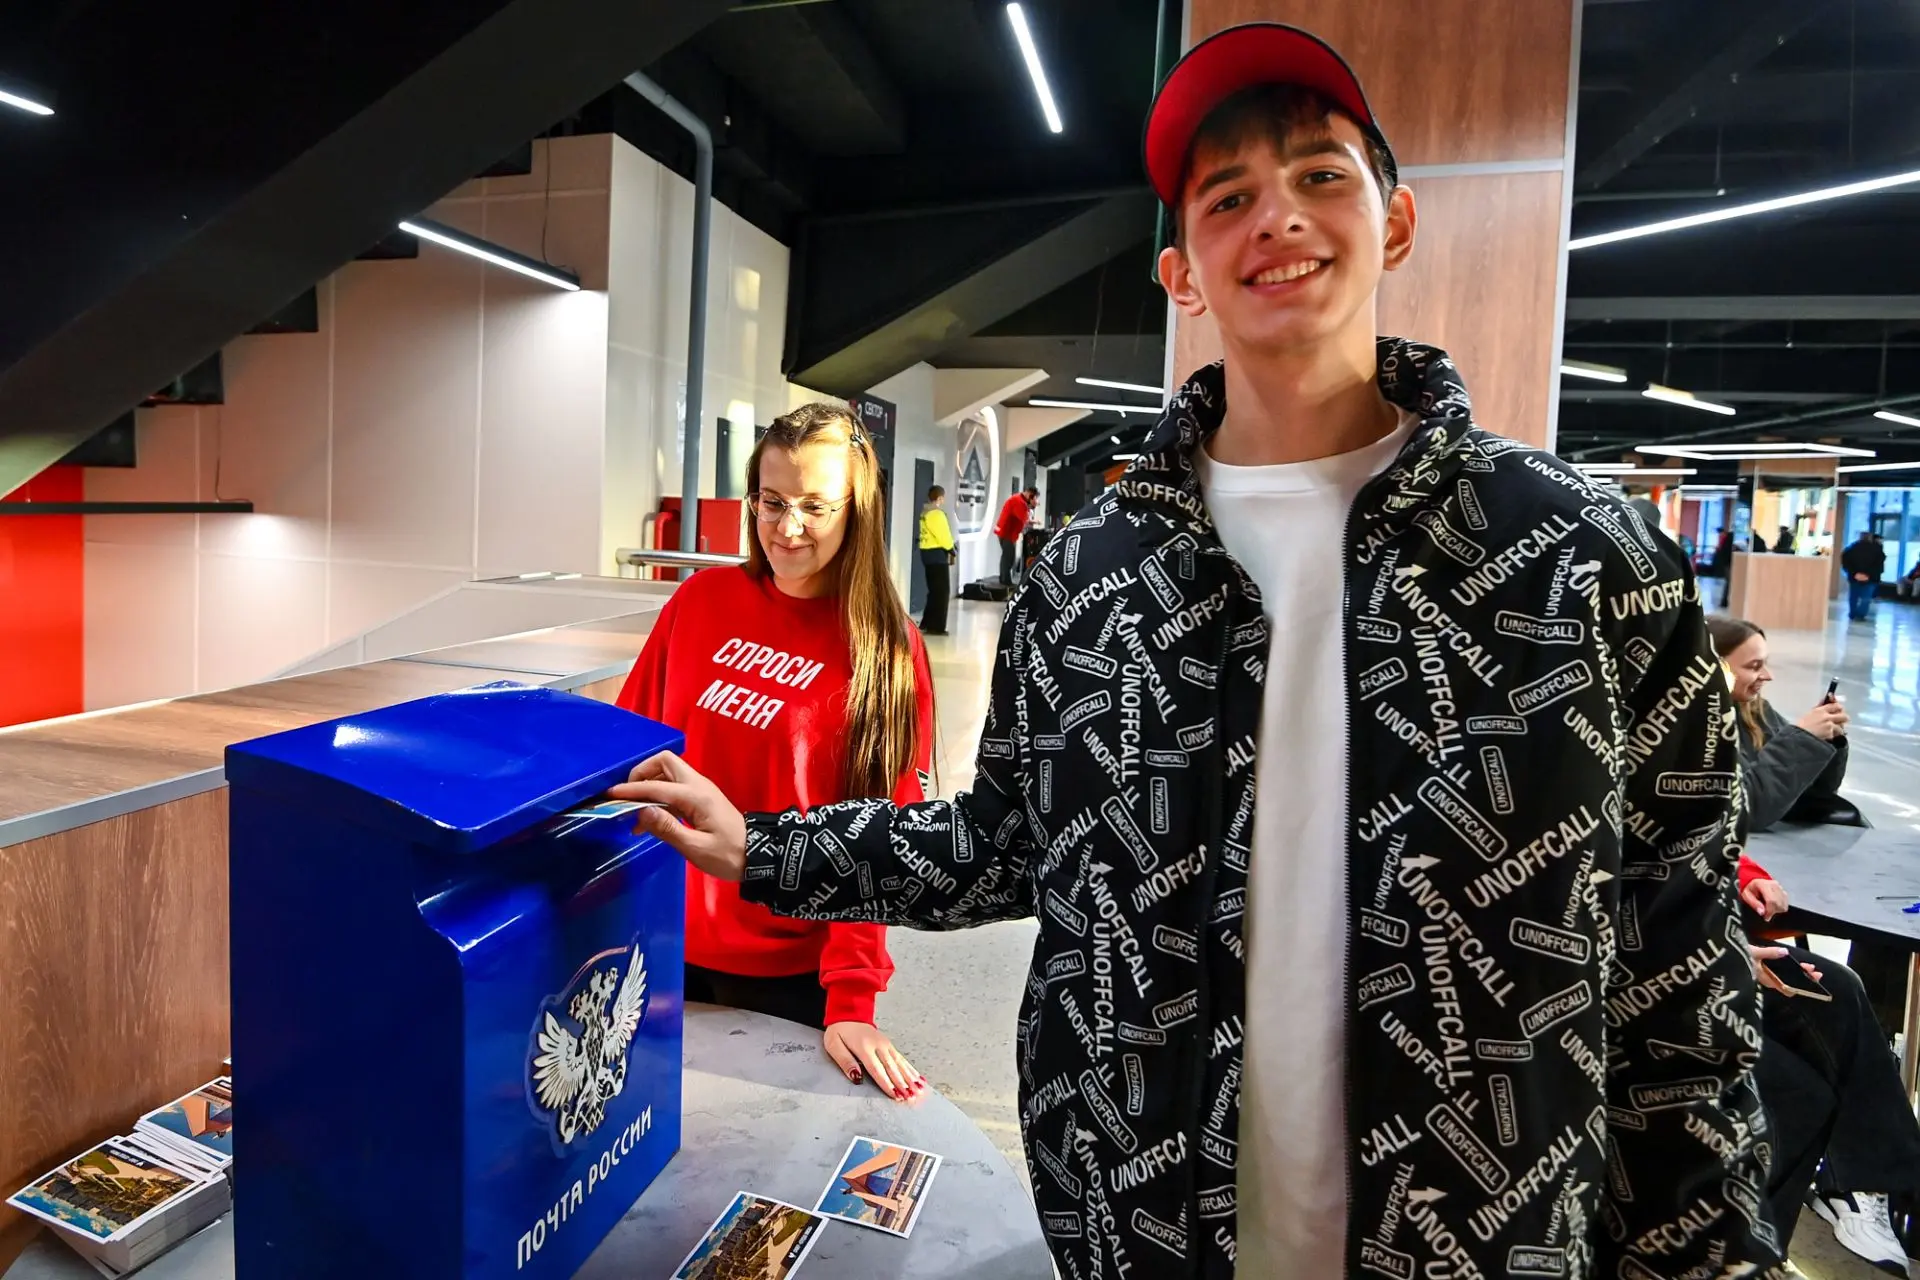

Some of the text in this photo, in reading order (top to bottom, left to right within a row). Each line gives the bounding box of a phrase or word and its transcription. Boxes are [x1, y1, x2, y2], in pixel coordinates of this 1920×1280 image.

[1523, 455, 1622, 524] UNOFFLL
[1450, 514, 1580, 607] UNOFFCALL
[1589, 511, 1651, 576] UNOFFCALL
[1045, 567, 1138, 646] UNOFFCALL
[1143, 561, 1178, 607] UNOFFCALL
[1367, 547, 1401, 616] UNOFFCALL
[1544, 545, 1577, 617] UNOFFCALL
[1012, 606, 1029, 667] UNOFFCALL
[1093, 595, 1129, 652] UNOFFCALL
[1391, 571, 1504, 688] UNOFFCALL
[1502, 616, 1577, 639] UNOFFCALL
[712, 637, 825, 690] СПРОСИ
[1115, 616, 1177, 725] UNOFFCALL
[1410, 625, 1465, 762] UNOFFCALL
[1514, 666, 1587, 710] UNOFFCALL
[696, 679, 785, 730] МЕНЯ
[1062, 696, 1107, 727] UNOFFCALL
[1118, 662, 1142, 783] UNOFFCALL
[1470, 719, 1524, 732] UNOFFCALL
[1625, 654, 1718, 776] UNOFFCALL
[1702, 691, 1721, 769] UNOFFCALL
[1082, 726, 1141, 810] UNOFFLL
[1374, 700, 1473, 791] UNOFFLL
[1485, 750, 1509, 810] UNOFFCALL
[1107, 801, 1153, 867] UNOFFCALL
[1154, 780, 1166, 831] UNOFFCALL
[1426, 784, 1499, 855] UNOFFCALL
[785, 836, 805, 886] UNOFFCALL
[1373, 831, 1408, 911] UNOFFCALL
[1463, 804, 1601, 909] UNOFFCALL
[1561, 849, 1596, 929] UNOFFCALL
[1086, 868, 1154, 1000] UNOFFCALL
[1397, 864, 1516, 1009] UNOFFCALL
[1517, 926, 1587, 958] UNOFFCALL
[1092, 922, 1115, 1059] UNOFFCALL
[1419, 924, 1474, 1088] UNOFFCALL
[1525, 990, 1588, 1030] UNOFFCALL
[1604, 938, 1727, 1029] UNOFFCALL
[1059, 987, 1115, 1090] UNOFFLL
[1120, 1026, 1163, 1043] UNOFFCALL
[1379, 1010, 1480, 1121] UNOFFLL
[1083, 1077, 1133, 1149] UNOFFCALL
[1130, 1056, 1142, 1111] UNOFFCALL
[1637, 1081, 1716, 1105] UNOFFCALL
[1436, 1113, 1501, 1187] UNOFFCALL
[1466, 1124, 1584, 1242] UNOFFCALL
[516, 1104, 651, 1271] ПОЧТА РОССИИ
[1376, 1162, 1415, 1245] UNOFFCALL
